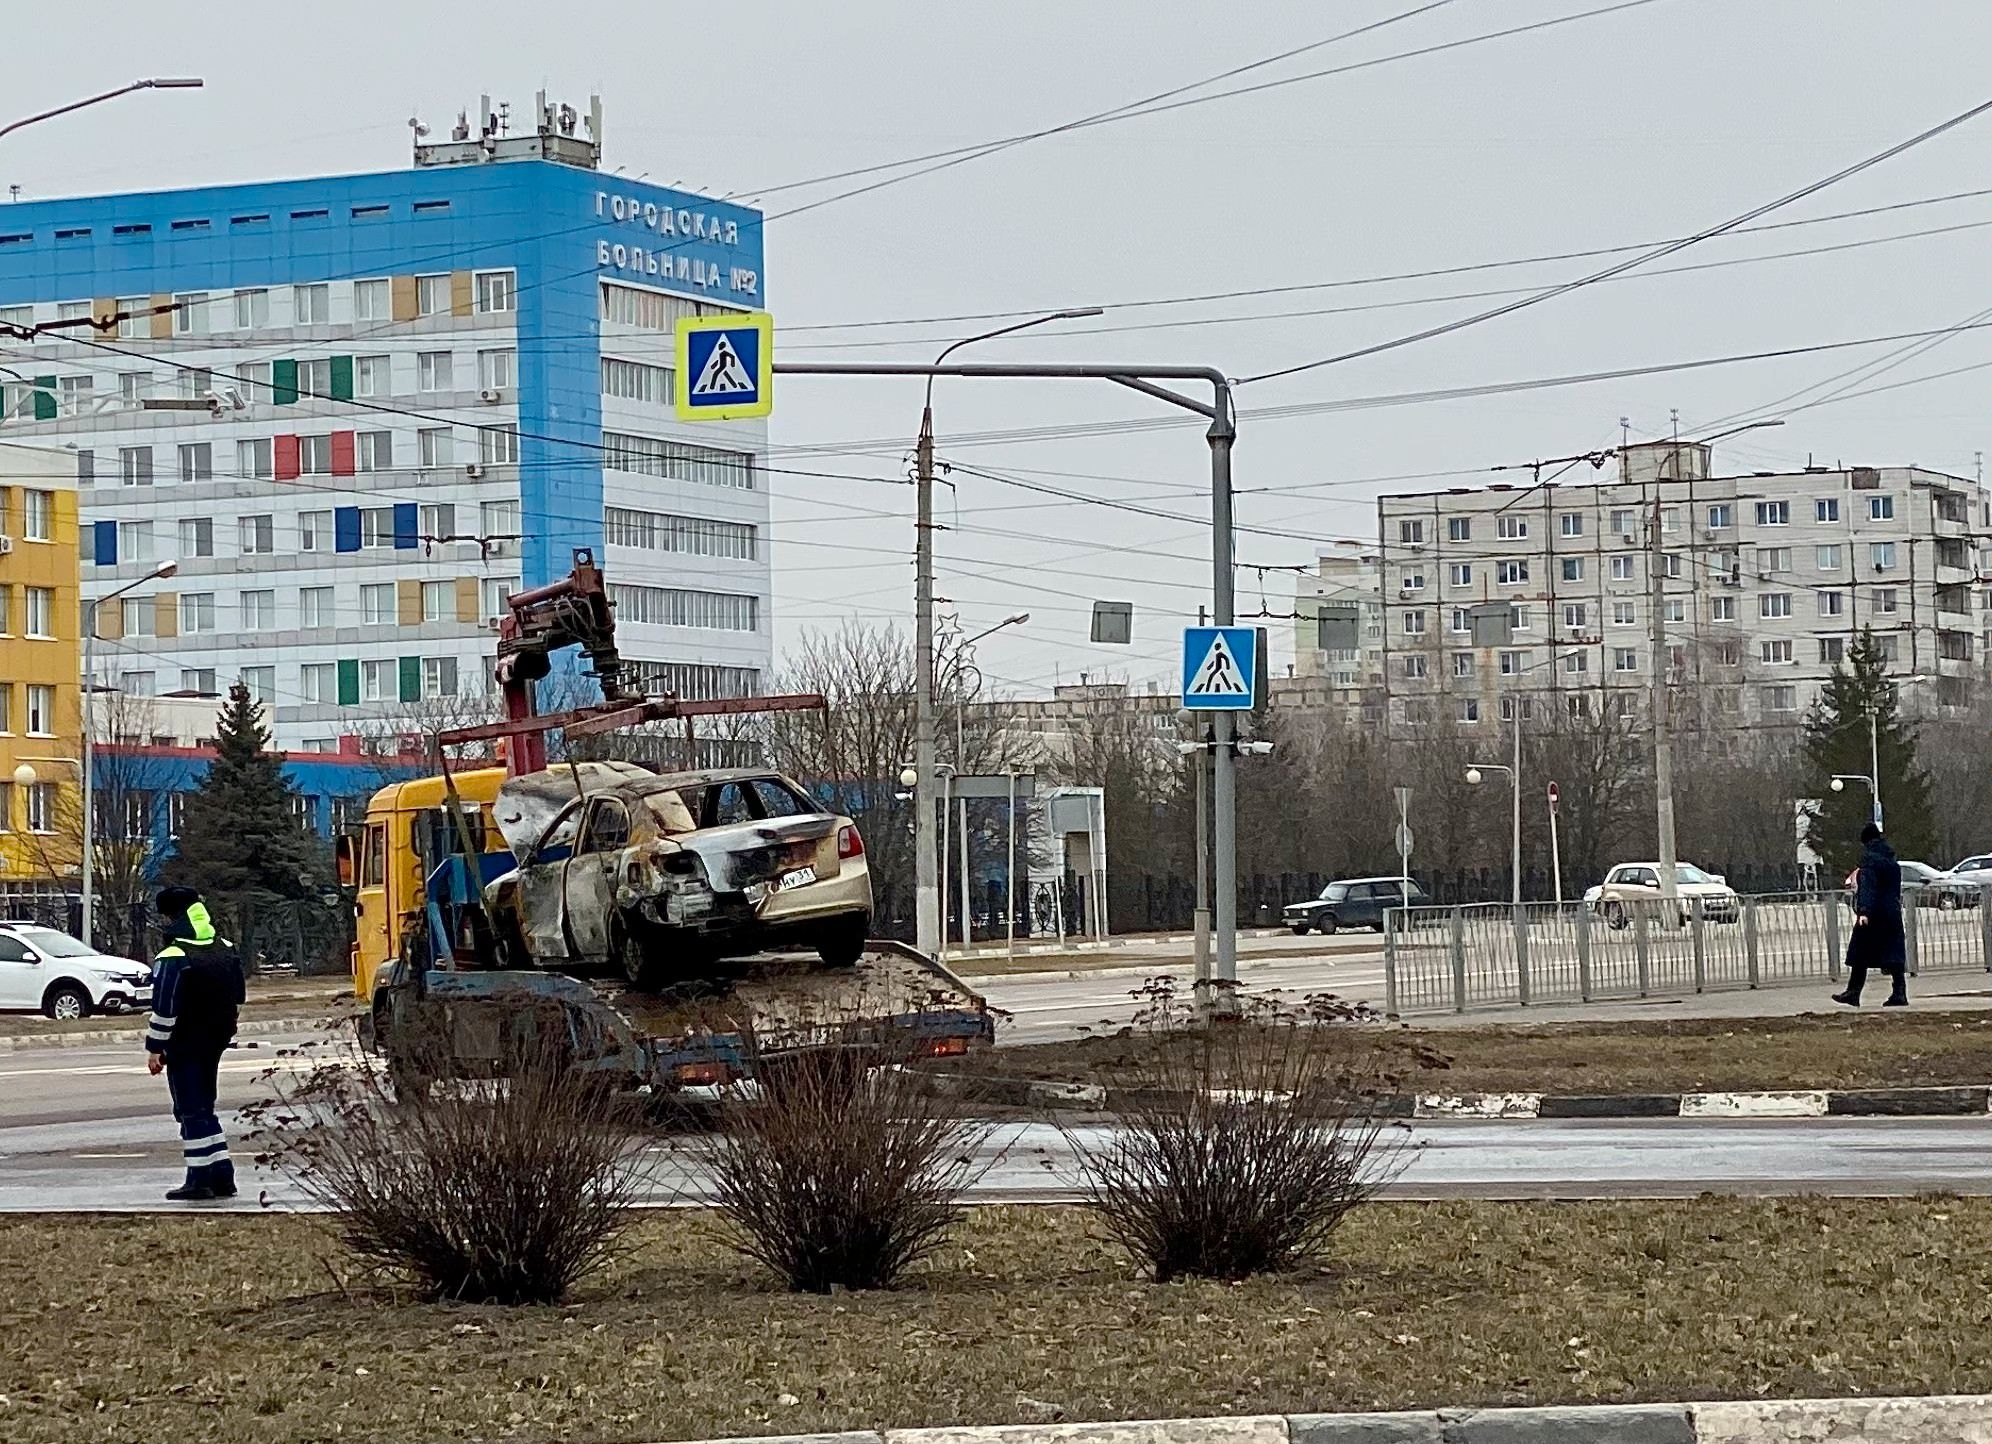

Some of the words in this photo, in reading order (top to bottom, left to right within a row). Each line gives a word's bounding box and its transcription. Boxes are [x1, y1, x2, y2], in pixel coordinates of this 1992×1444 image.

[595, 190, 738, 245] ГОРОДСКАЯ
[597, 240, 721, 290] БОЛЬНИЦА
[729, 266, 757, 295] №2
